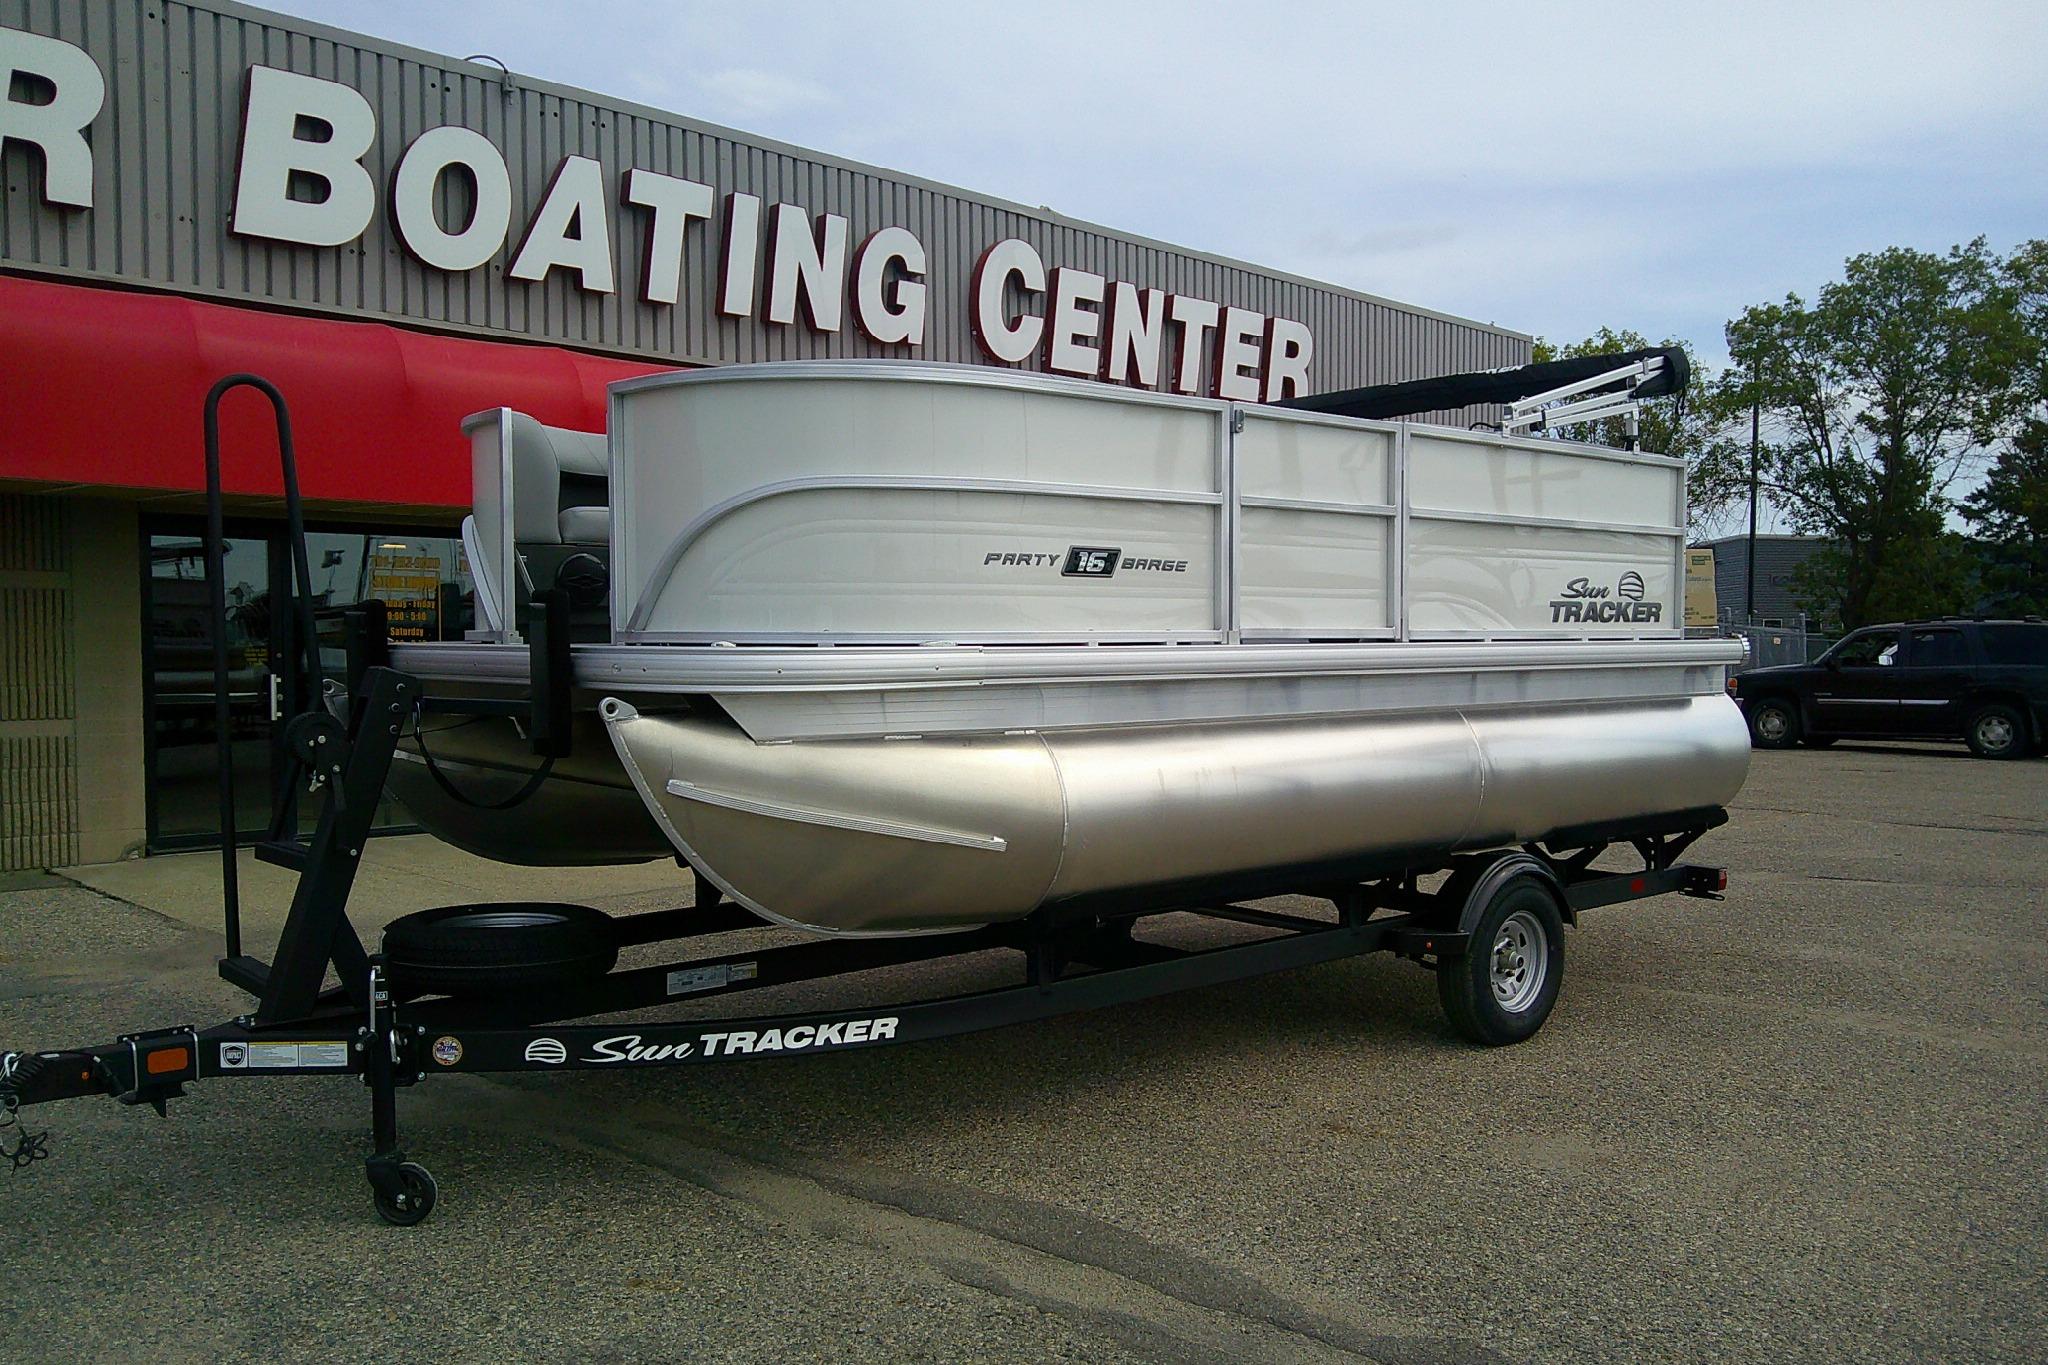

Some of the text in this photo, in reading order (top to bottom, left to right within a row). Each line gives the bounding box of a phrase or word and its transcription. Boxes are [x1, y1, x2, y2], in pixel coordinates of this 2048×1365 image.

[229, 63, 927, 347] BOATING
[969, 238, 1314, 403] CENTER
[983, 551, 1188, 572] PARTY 16 BARGE
[1560, 577, 1610, 599] Sun
[1550, 600, 1662, 623] TRACKER
[390, 627, 424, 637] Saturday
[579, 1017, 899, 1063] Sun TRACKER
